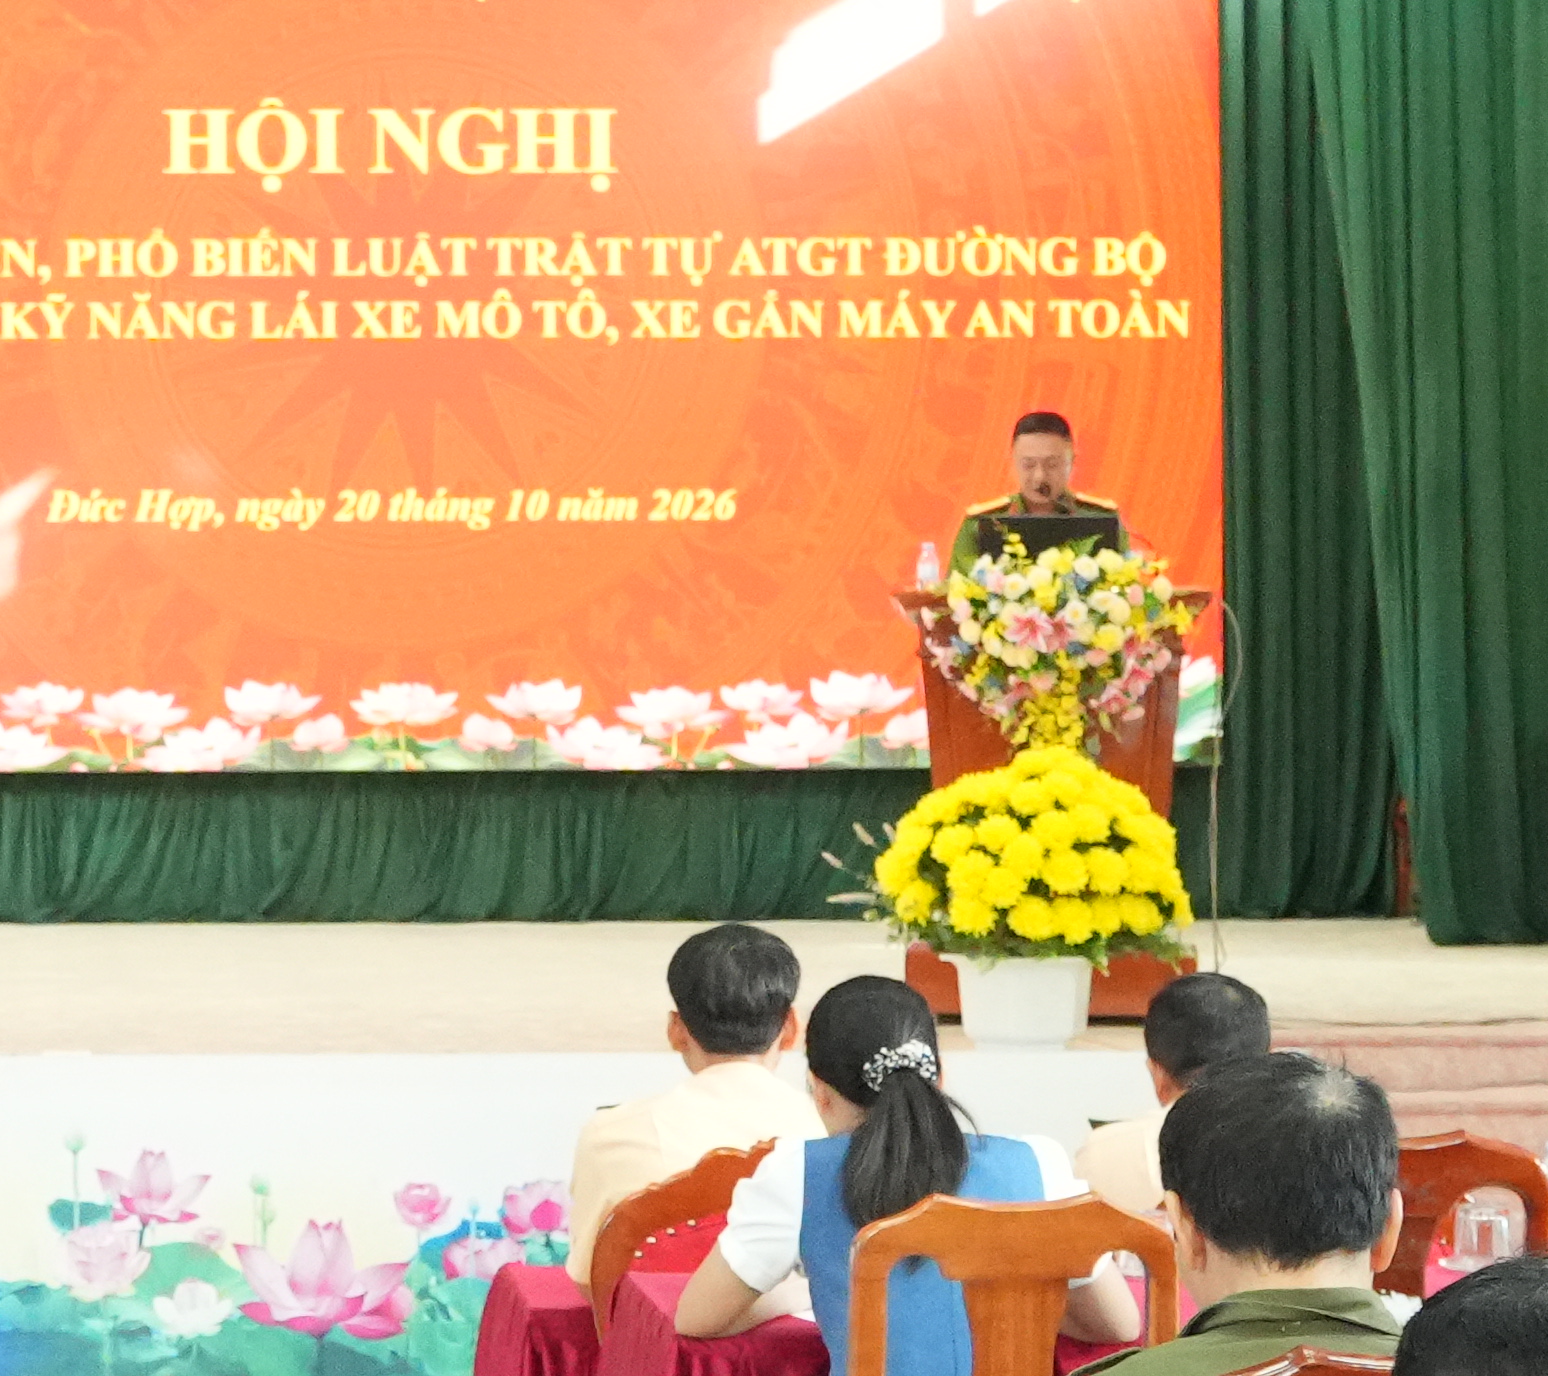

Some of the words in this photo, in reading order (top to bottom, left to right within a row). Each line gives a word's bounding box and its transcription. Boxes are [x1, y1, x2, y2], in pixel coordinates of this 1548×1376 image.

[163, 98, 344, 192] HỘI
[369, 109, 618, 192] NGHỊ
[67, 230, 178, 277] PHỔ
[193, 228, 316, 276] BIẾN
[334, 233, 476, 287] LUẬT
[487, 234, 632, 286] TRẬT
[642, 231, 723, 286] TỰ
[730, 238, 872, 276] ATGT
[885, 226, 1078, 276] ĐƯỜNG
[1095, 232, 1166, 286] BỘ
[1, 294, 74, 339] KỸ
[88, 293, 235, 339] NĂNG
[251, 290, 337, 338] LÁI
[352, 301, 421, 338] XE
[436, 288, 522, 338] MÔ
[533, 288, 619, 343] TÔ,
[631, 301, 700, 337] XE
[713, 290, 823, 337] GẮN
[839, 290, 956, 337] MÁY
[966, 301, 1035, 337] AN
[1049, 290, 1189, 337] TOÀN
[47, 490, 126, 523] Đức
[135, 489, 224, 531] Hợp,
[236, 488, 325, 530] ngày
[334, 490, 380, 522] 20
[388, 487, 494, 529] tháng
[507, 490, 549, 521] 10
[558, 489, 638, 521] năm
[648, 489, 736, 521] 2026
